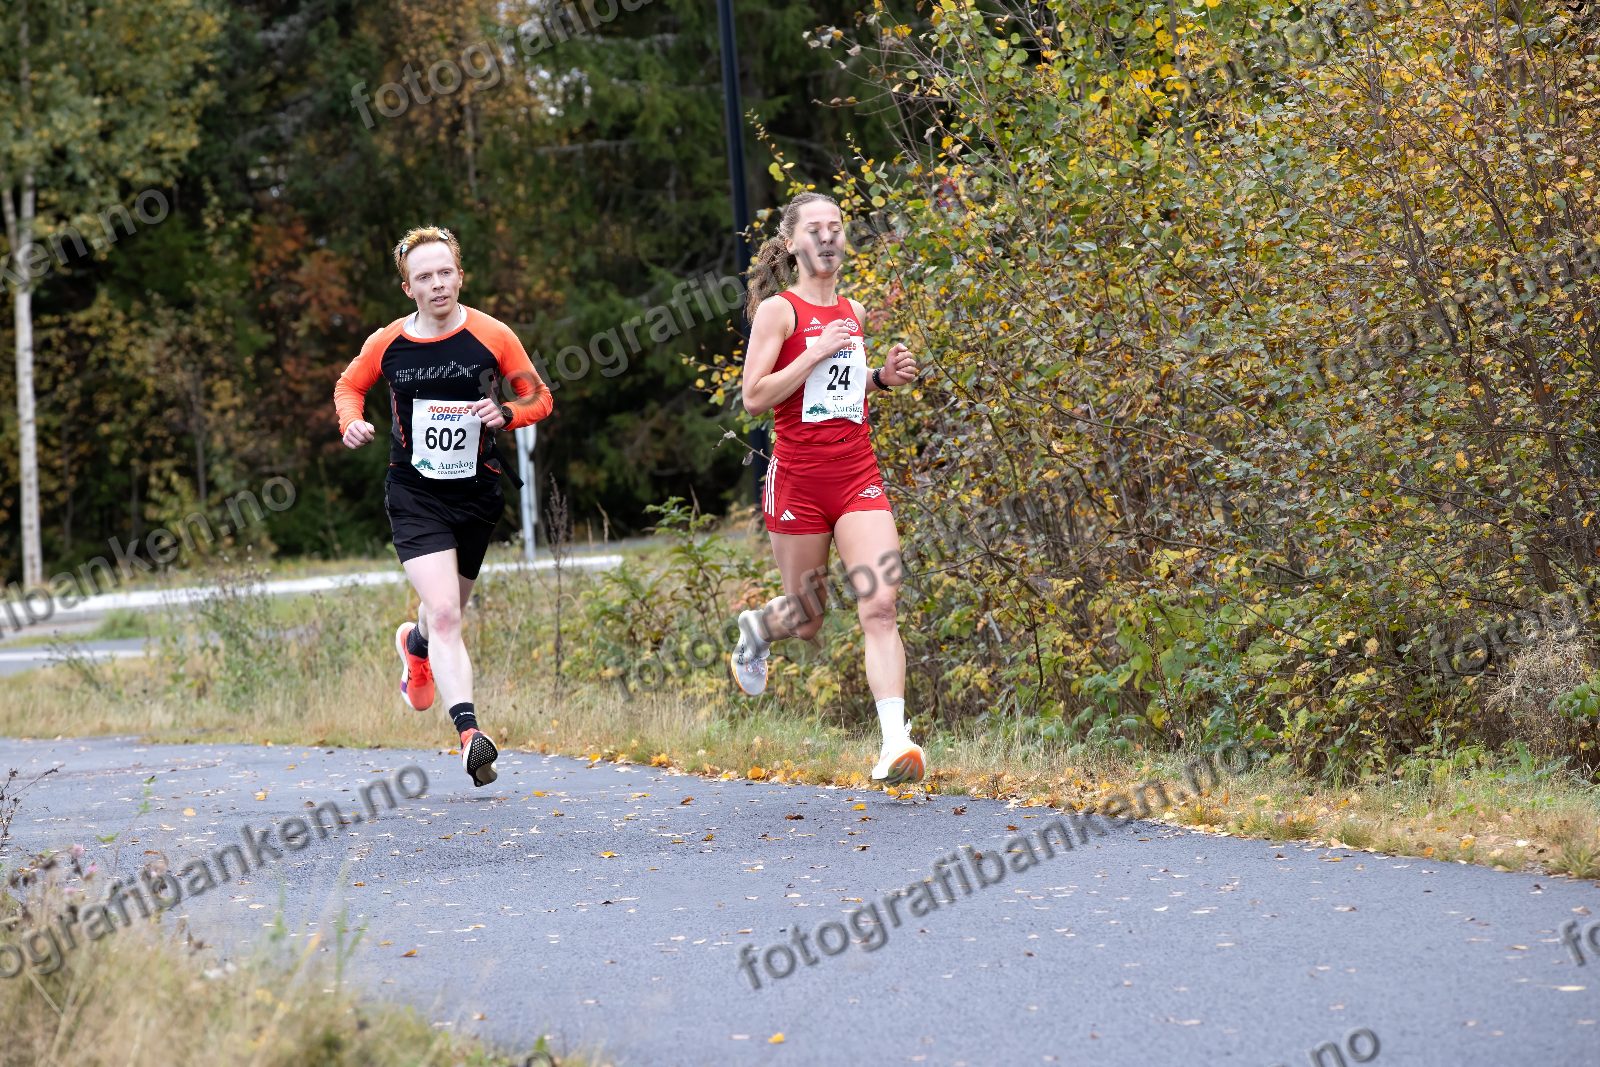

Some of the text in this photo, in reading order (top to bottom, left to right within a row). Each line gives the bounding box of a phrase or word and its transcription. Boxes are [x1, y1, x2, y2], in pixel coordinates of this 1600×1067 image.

[831, 350, 853, 359] ØPET
[827, 364, 851, 391] 24
[428, 405, 470, 414] NORGES
[431, 413, 463, 421] LØPET
[425, 426, 467, 451] 602
[438, 460, 474, 470] Aurskog
